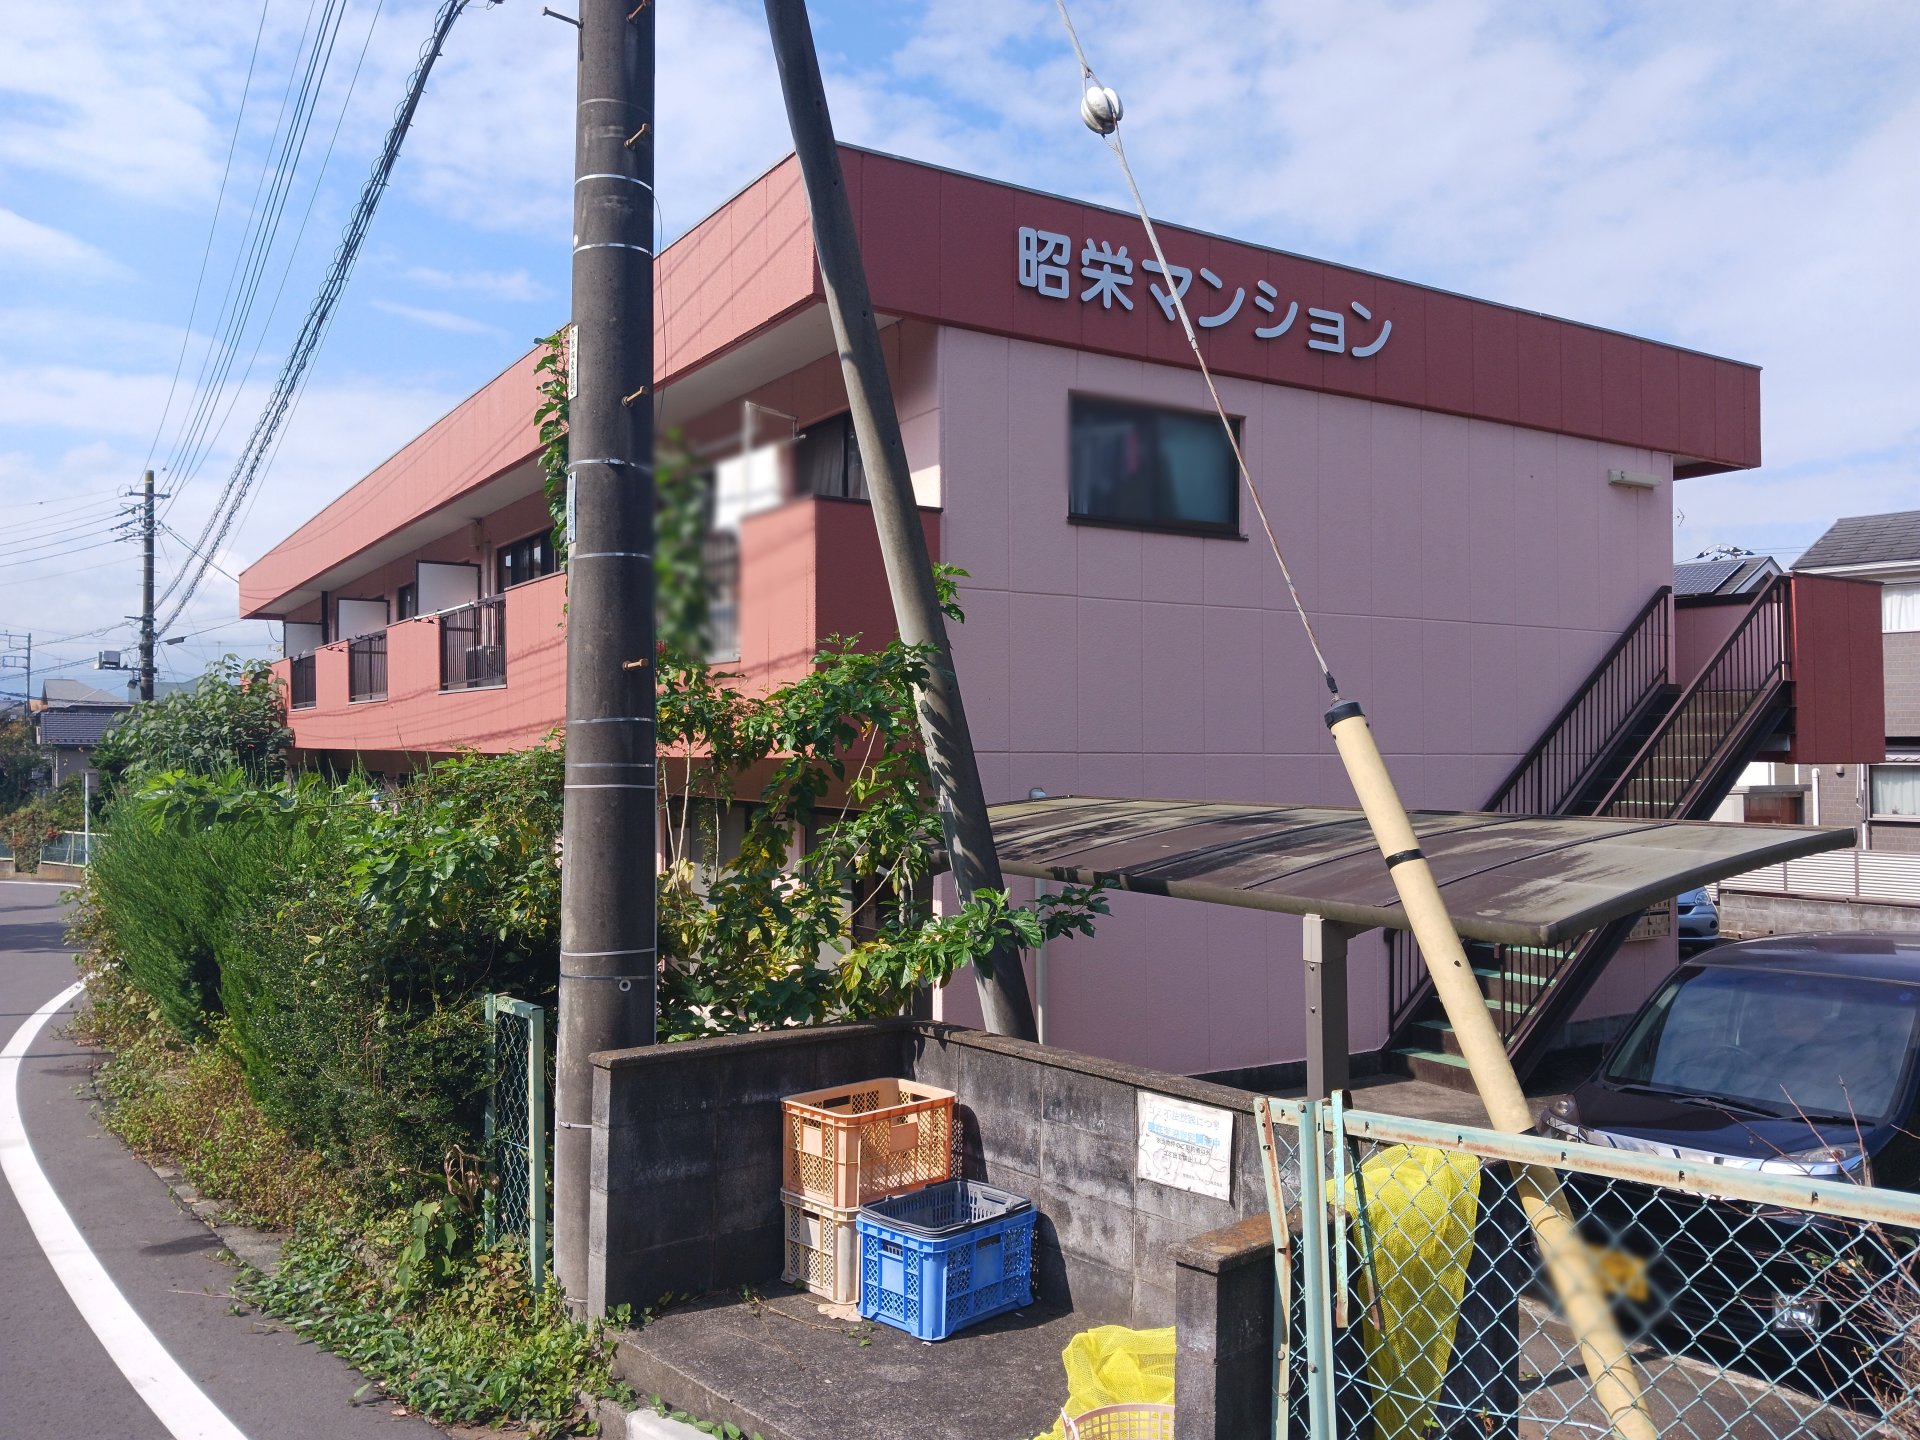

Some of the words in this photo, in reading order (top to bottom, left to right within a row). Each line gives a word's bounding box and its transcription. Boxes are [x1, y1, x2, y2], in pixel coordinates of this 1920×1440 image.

[1018, 226, 1392, 358] 昭栄マンション
